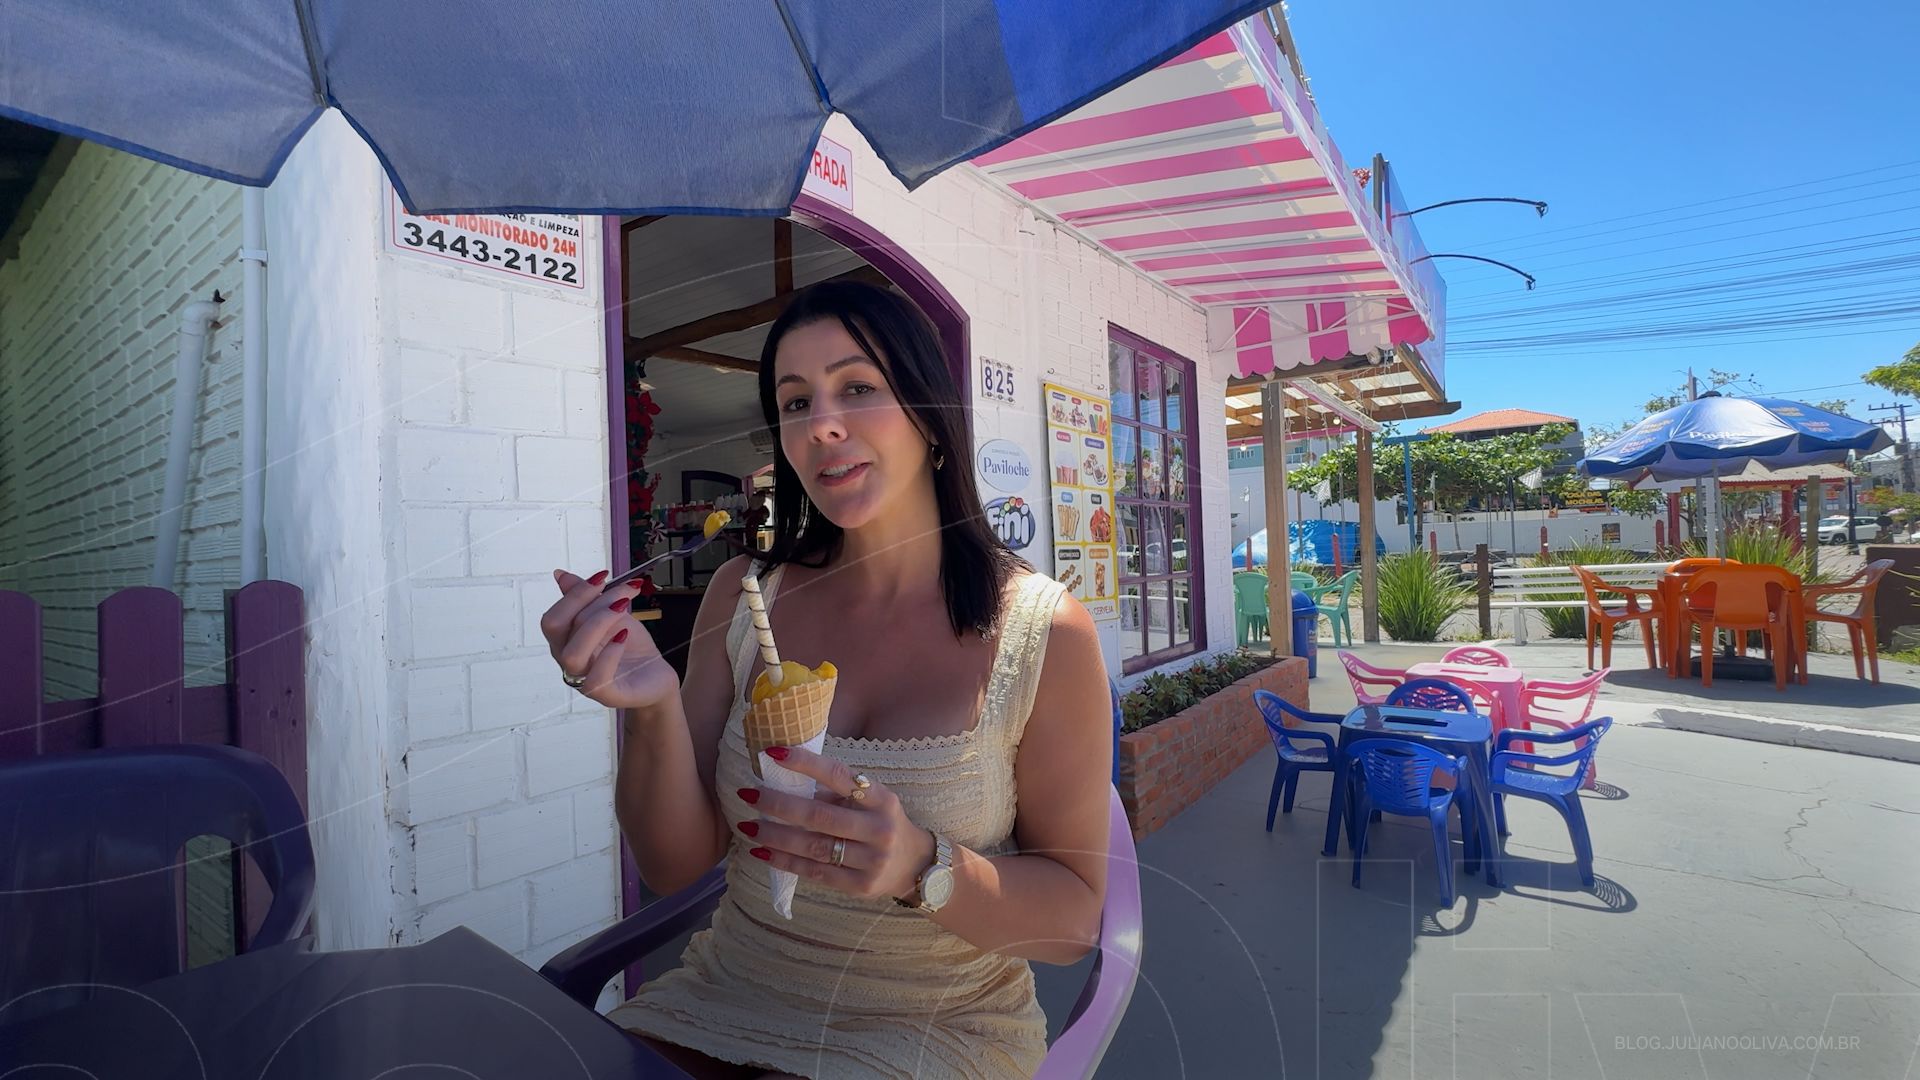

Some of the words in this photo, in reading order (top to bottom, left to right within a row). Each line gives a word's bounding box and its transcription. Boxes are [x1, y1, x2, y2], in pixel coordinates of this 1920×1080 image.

[809, 151, 848, 191] RADA
[455, 214, 548, 251] MONITORADO
[553, 237, 577, 258] 24H
[530, 216, 536, 225] E
[539, 219, 580, 237] LIMPEZA
[403, 222, 577, 284] 3443-2122
[985, 366, 1014, 396] 825
[984, 457, 1030, 476] Paviloche
